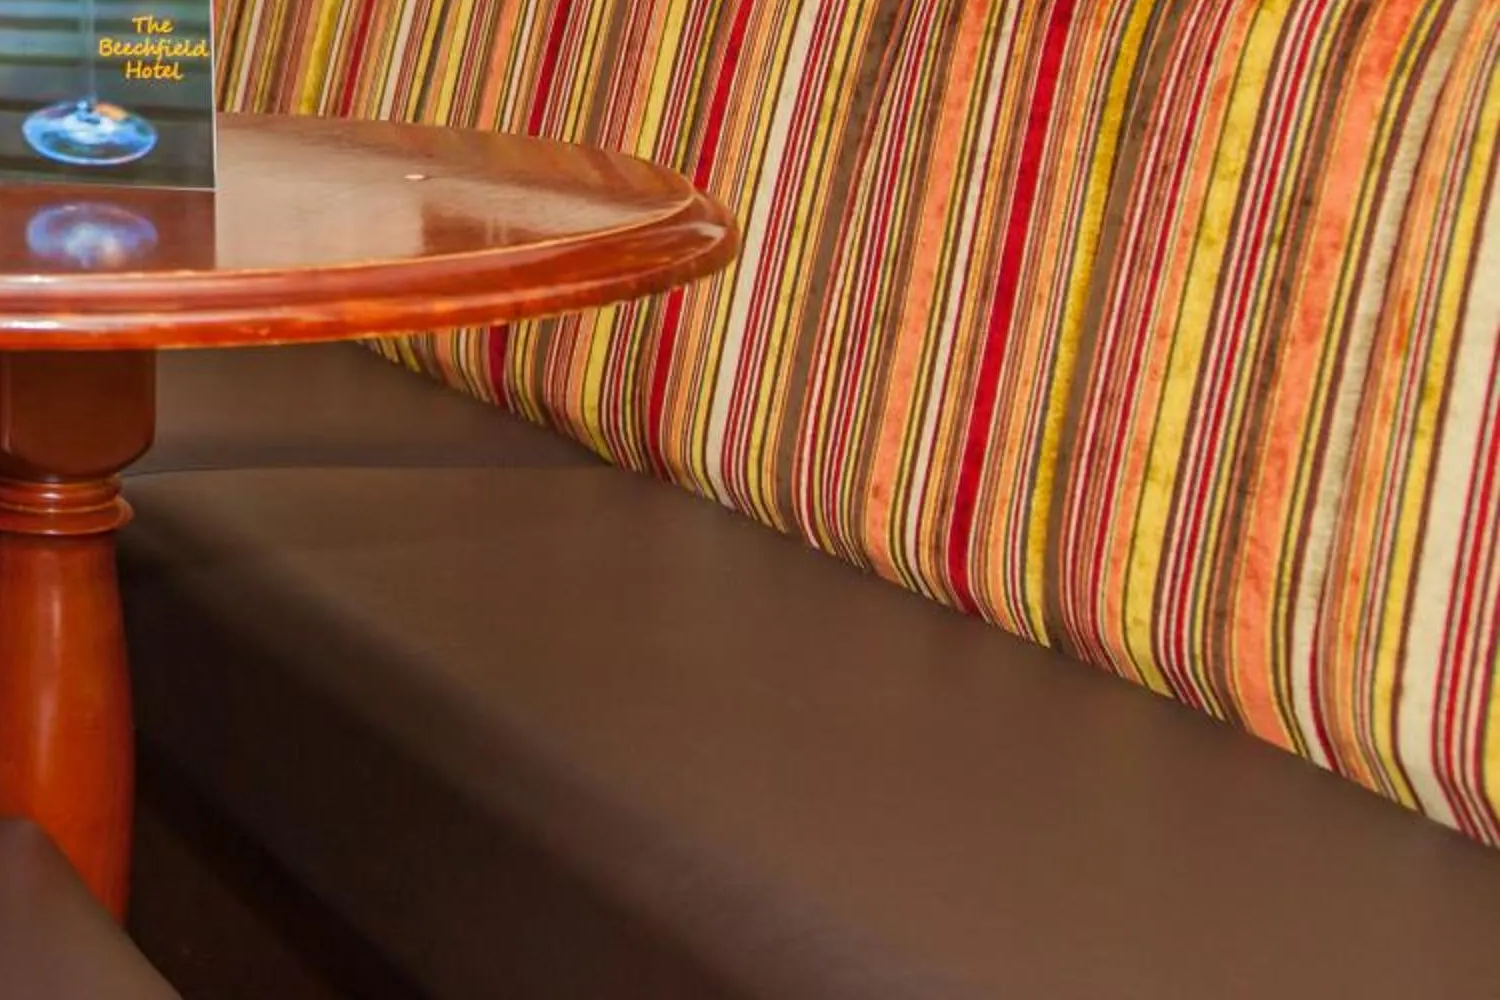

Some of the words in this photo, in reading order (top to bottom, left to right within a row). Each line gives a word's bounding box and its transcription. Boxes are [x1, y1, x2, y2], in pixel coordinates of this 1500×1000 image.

[131, 14, 174, 34] The
[99, 36, 210, 62] Beechfield
[125, 60, 184, 80] Hotel
